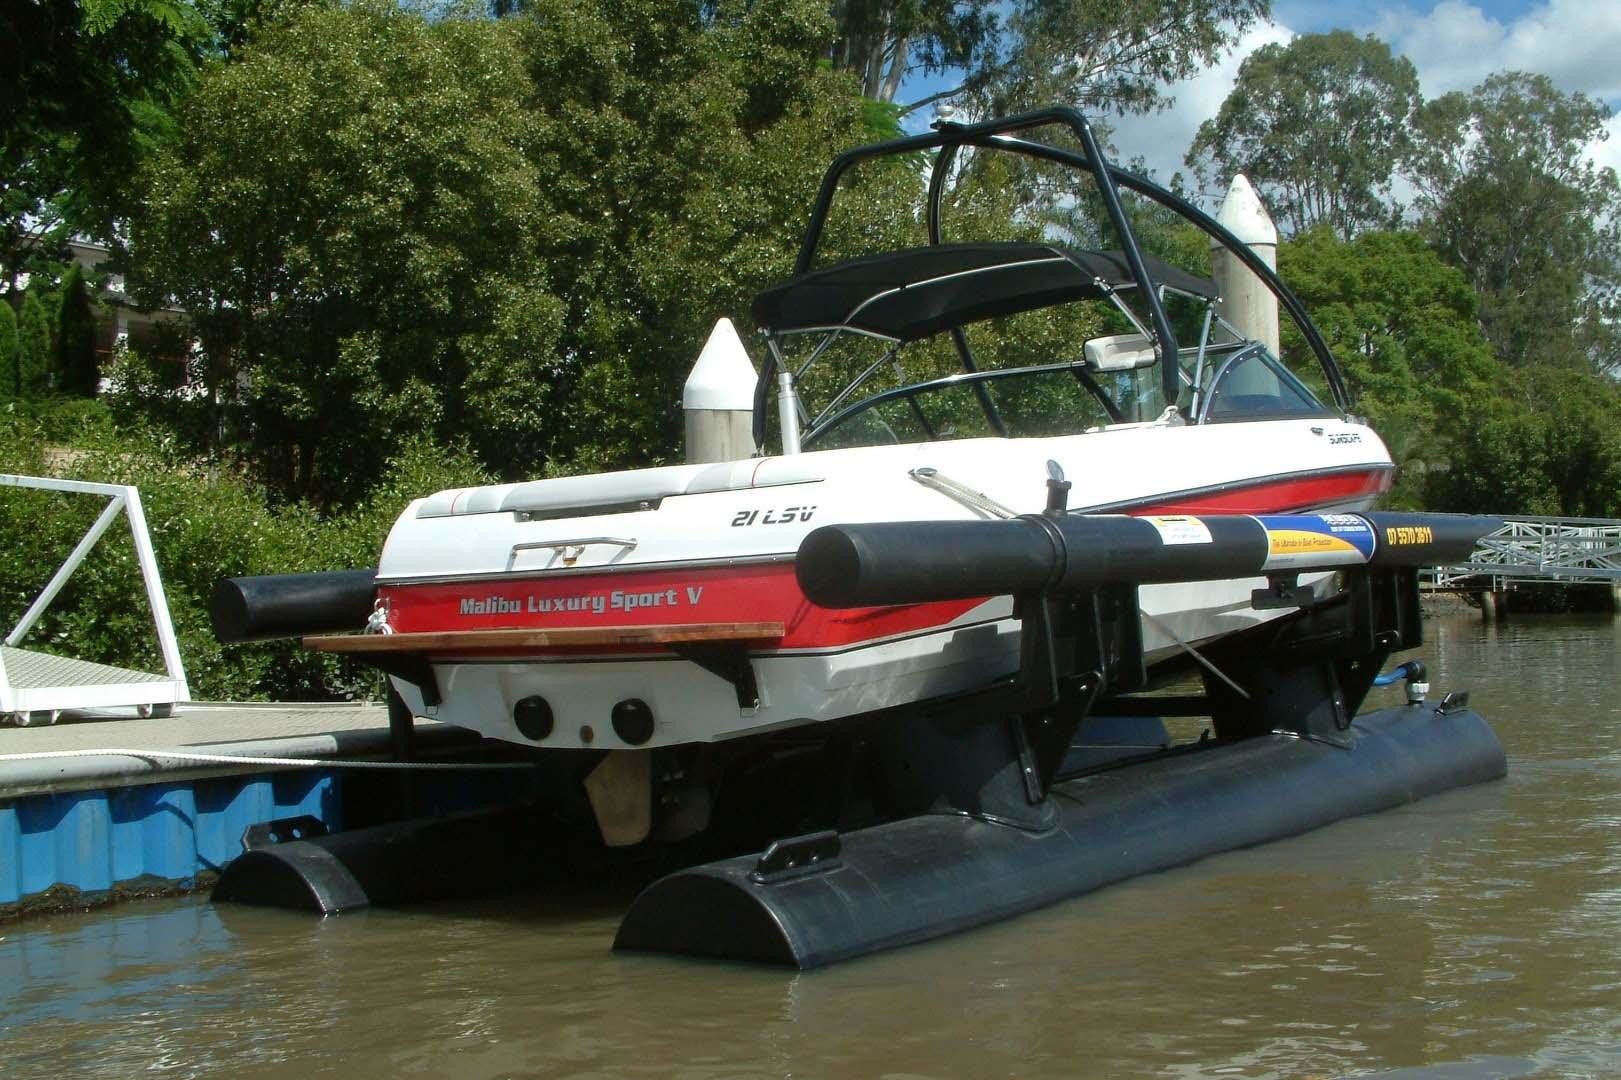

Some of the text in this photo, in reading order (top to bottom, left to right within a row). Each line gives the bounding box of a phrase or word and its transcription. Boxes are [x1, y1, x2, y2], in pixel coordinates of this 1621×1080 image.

[459, 586, 703, 615] Malibu Luxury Sport V
